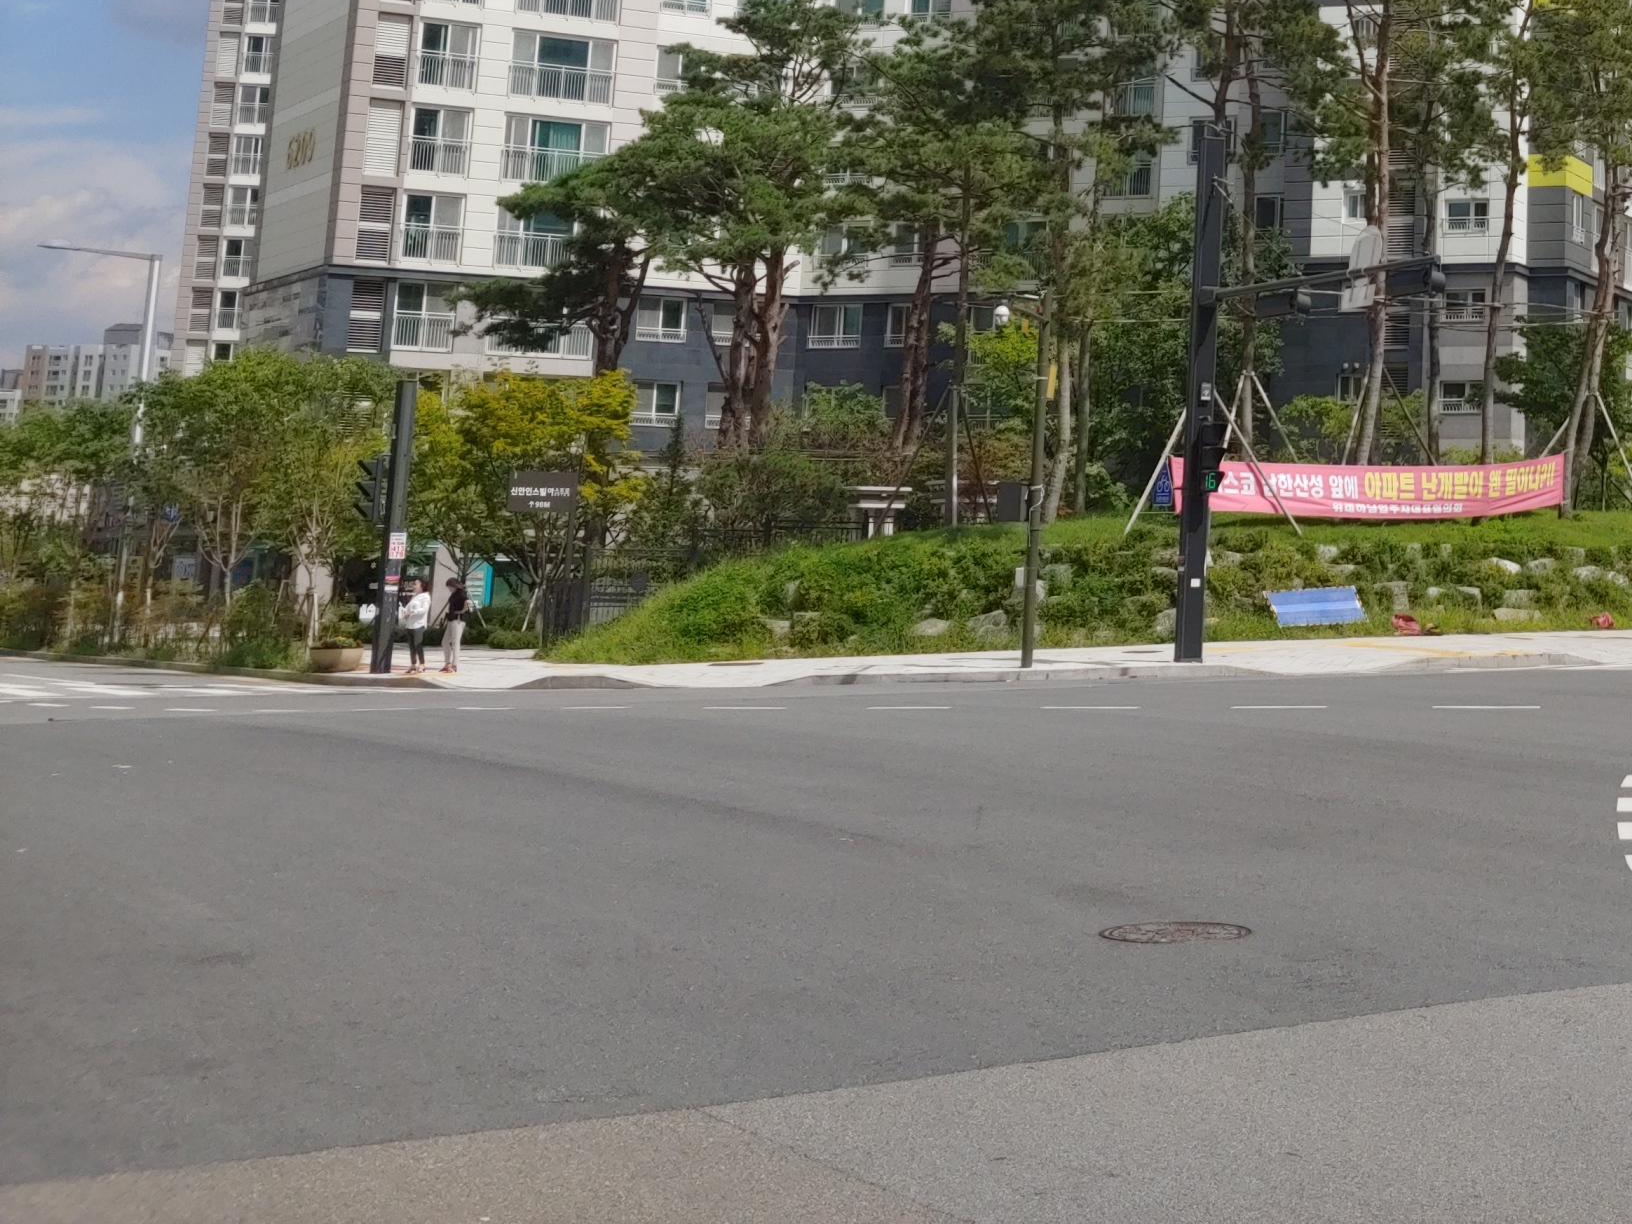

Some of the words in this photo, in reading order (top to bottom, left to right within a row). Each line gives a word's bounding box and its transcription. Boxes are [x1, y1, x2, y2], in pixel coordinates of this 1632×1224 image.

[1205, 473, 1216, 489] 16
[1217, 471, 1256, 495] 스코
[1328, 474, 1359, 499] 앞에
[1364, 471, 1415, 501] 아파트
[1421, 470, 1484, 501] 난개발이
[510, 487, 547, 496] 신안인스빌
